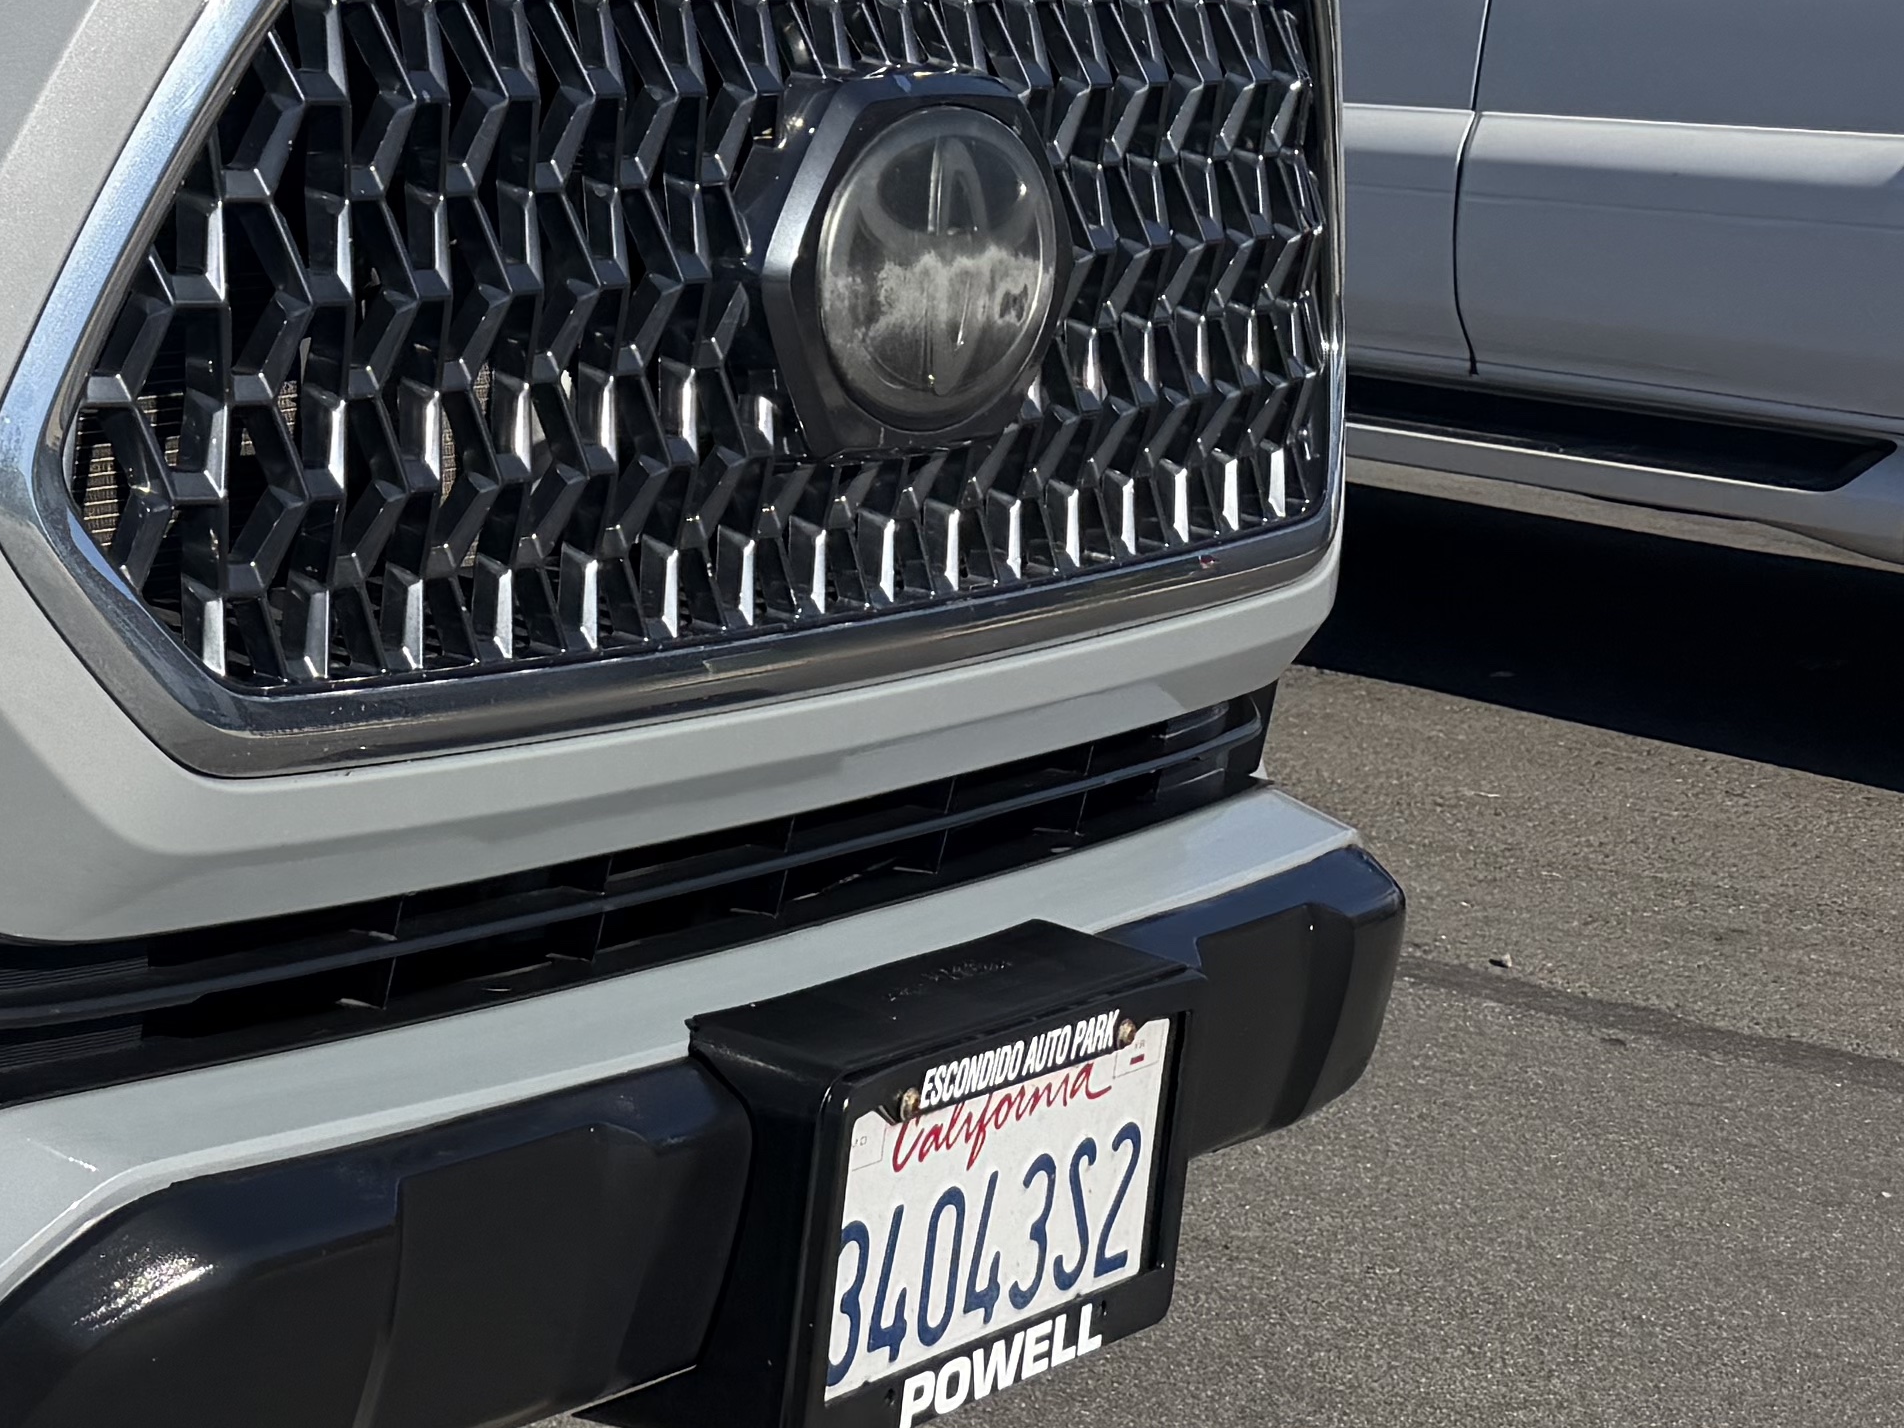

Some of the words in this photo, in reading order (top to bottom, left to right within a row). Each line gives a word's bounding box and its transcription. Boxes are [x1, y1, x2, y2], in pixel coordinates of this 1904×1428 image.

[919, 1040, 1025, 1109] ESCONDIDO
[1021, 1024, 1073, 1076] AUTO
[1070, 1008, 1120, 1059] PARK
[892, 1062, 1112, 1173] California
[827, 1121, 1142, 1387] 34043S2
